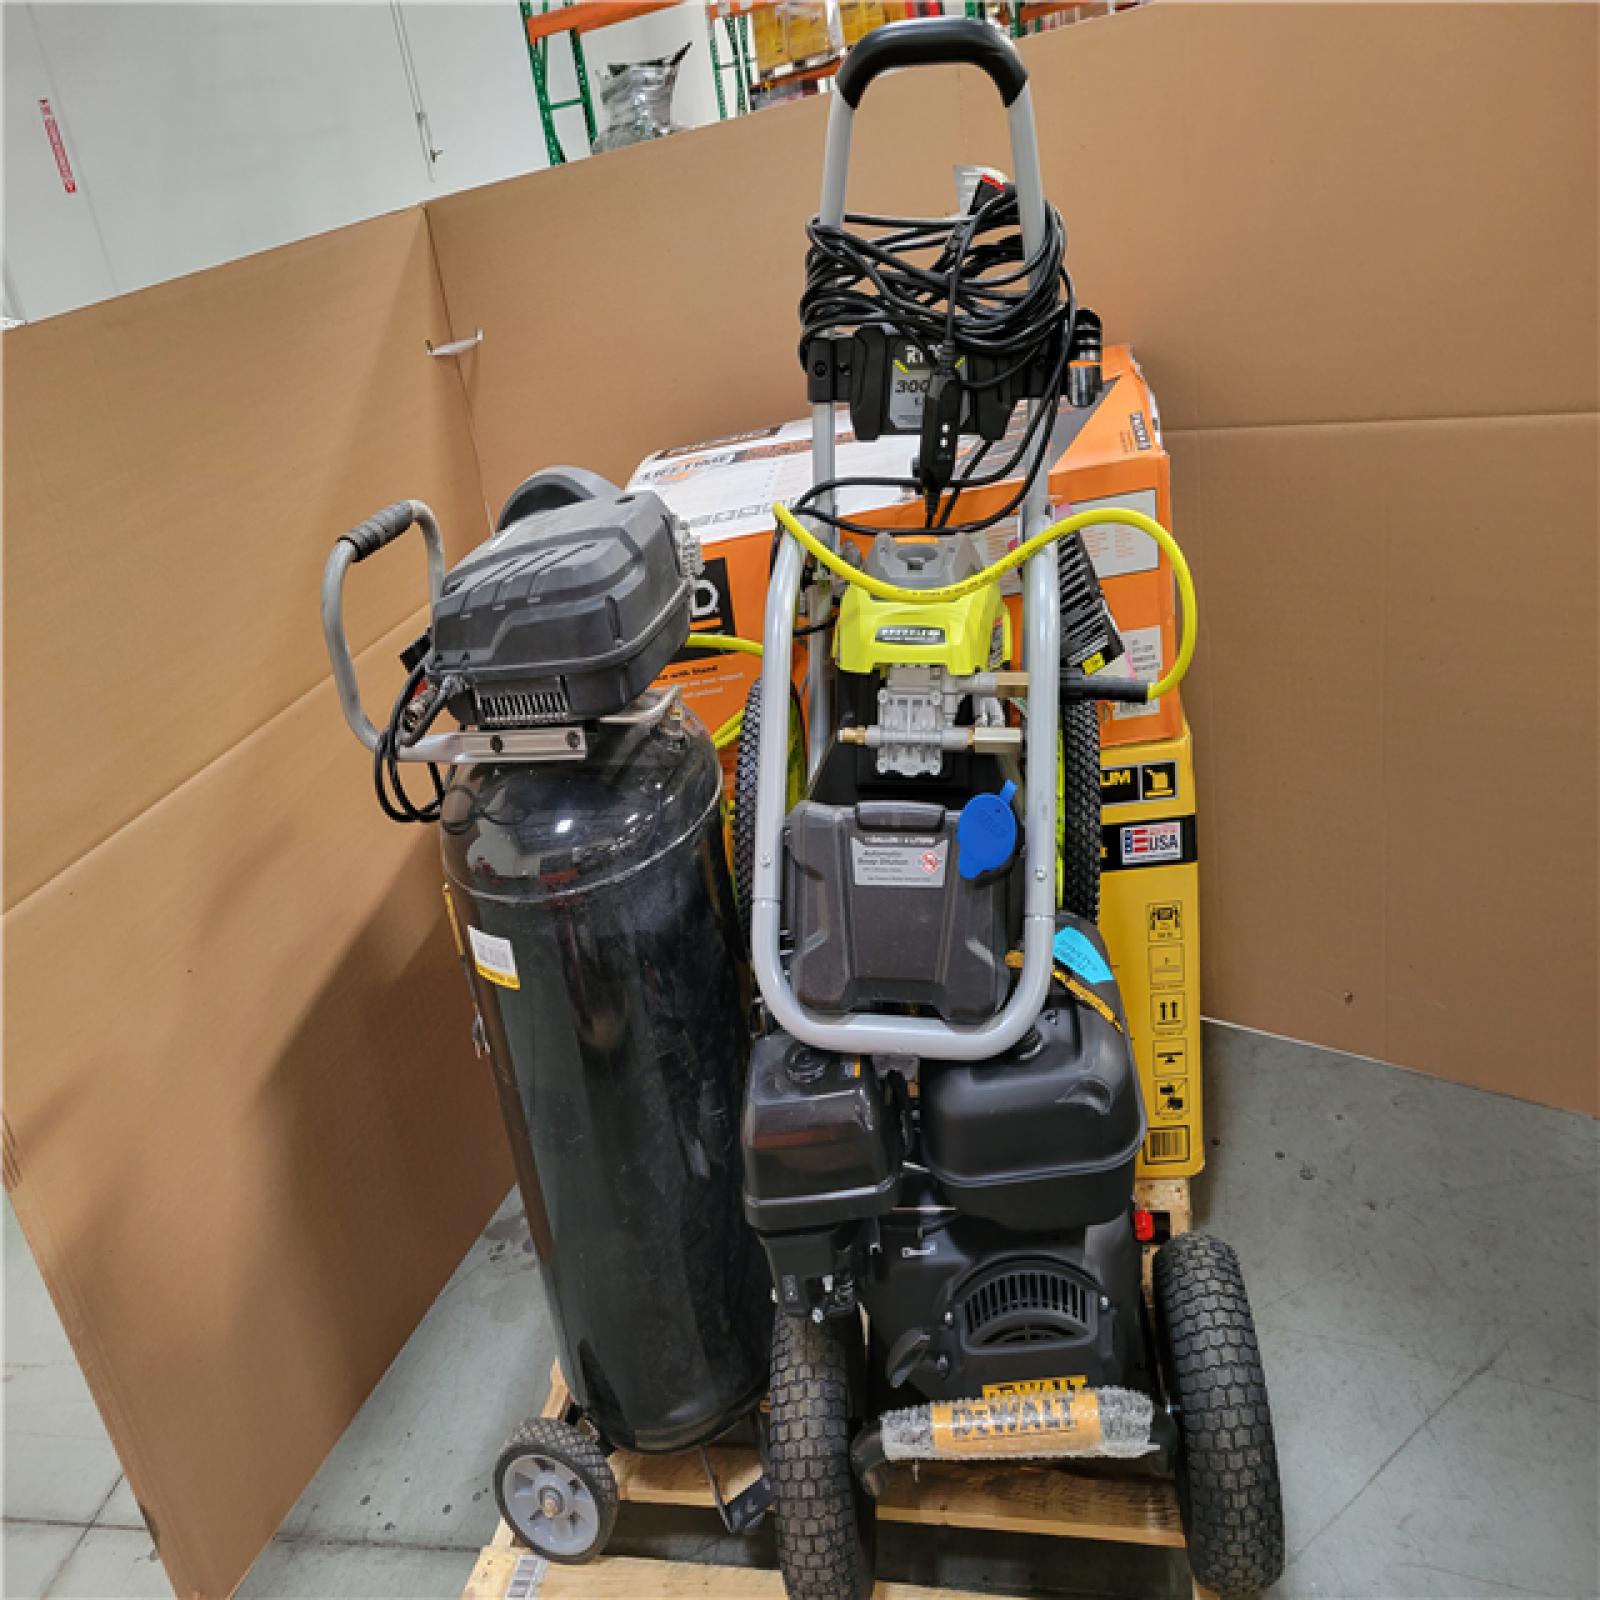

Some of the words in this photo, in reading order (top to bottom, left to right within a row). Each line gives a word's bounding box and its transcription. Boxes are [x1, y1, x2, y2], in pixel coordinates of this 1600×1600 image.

[894, 379, 930, 393] 300
[1100, 769, 1131, 786] UM
[1149, 834, 1178, 851] USA
